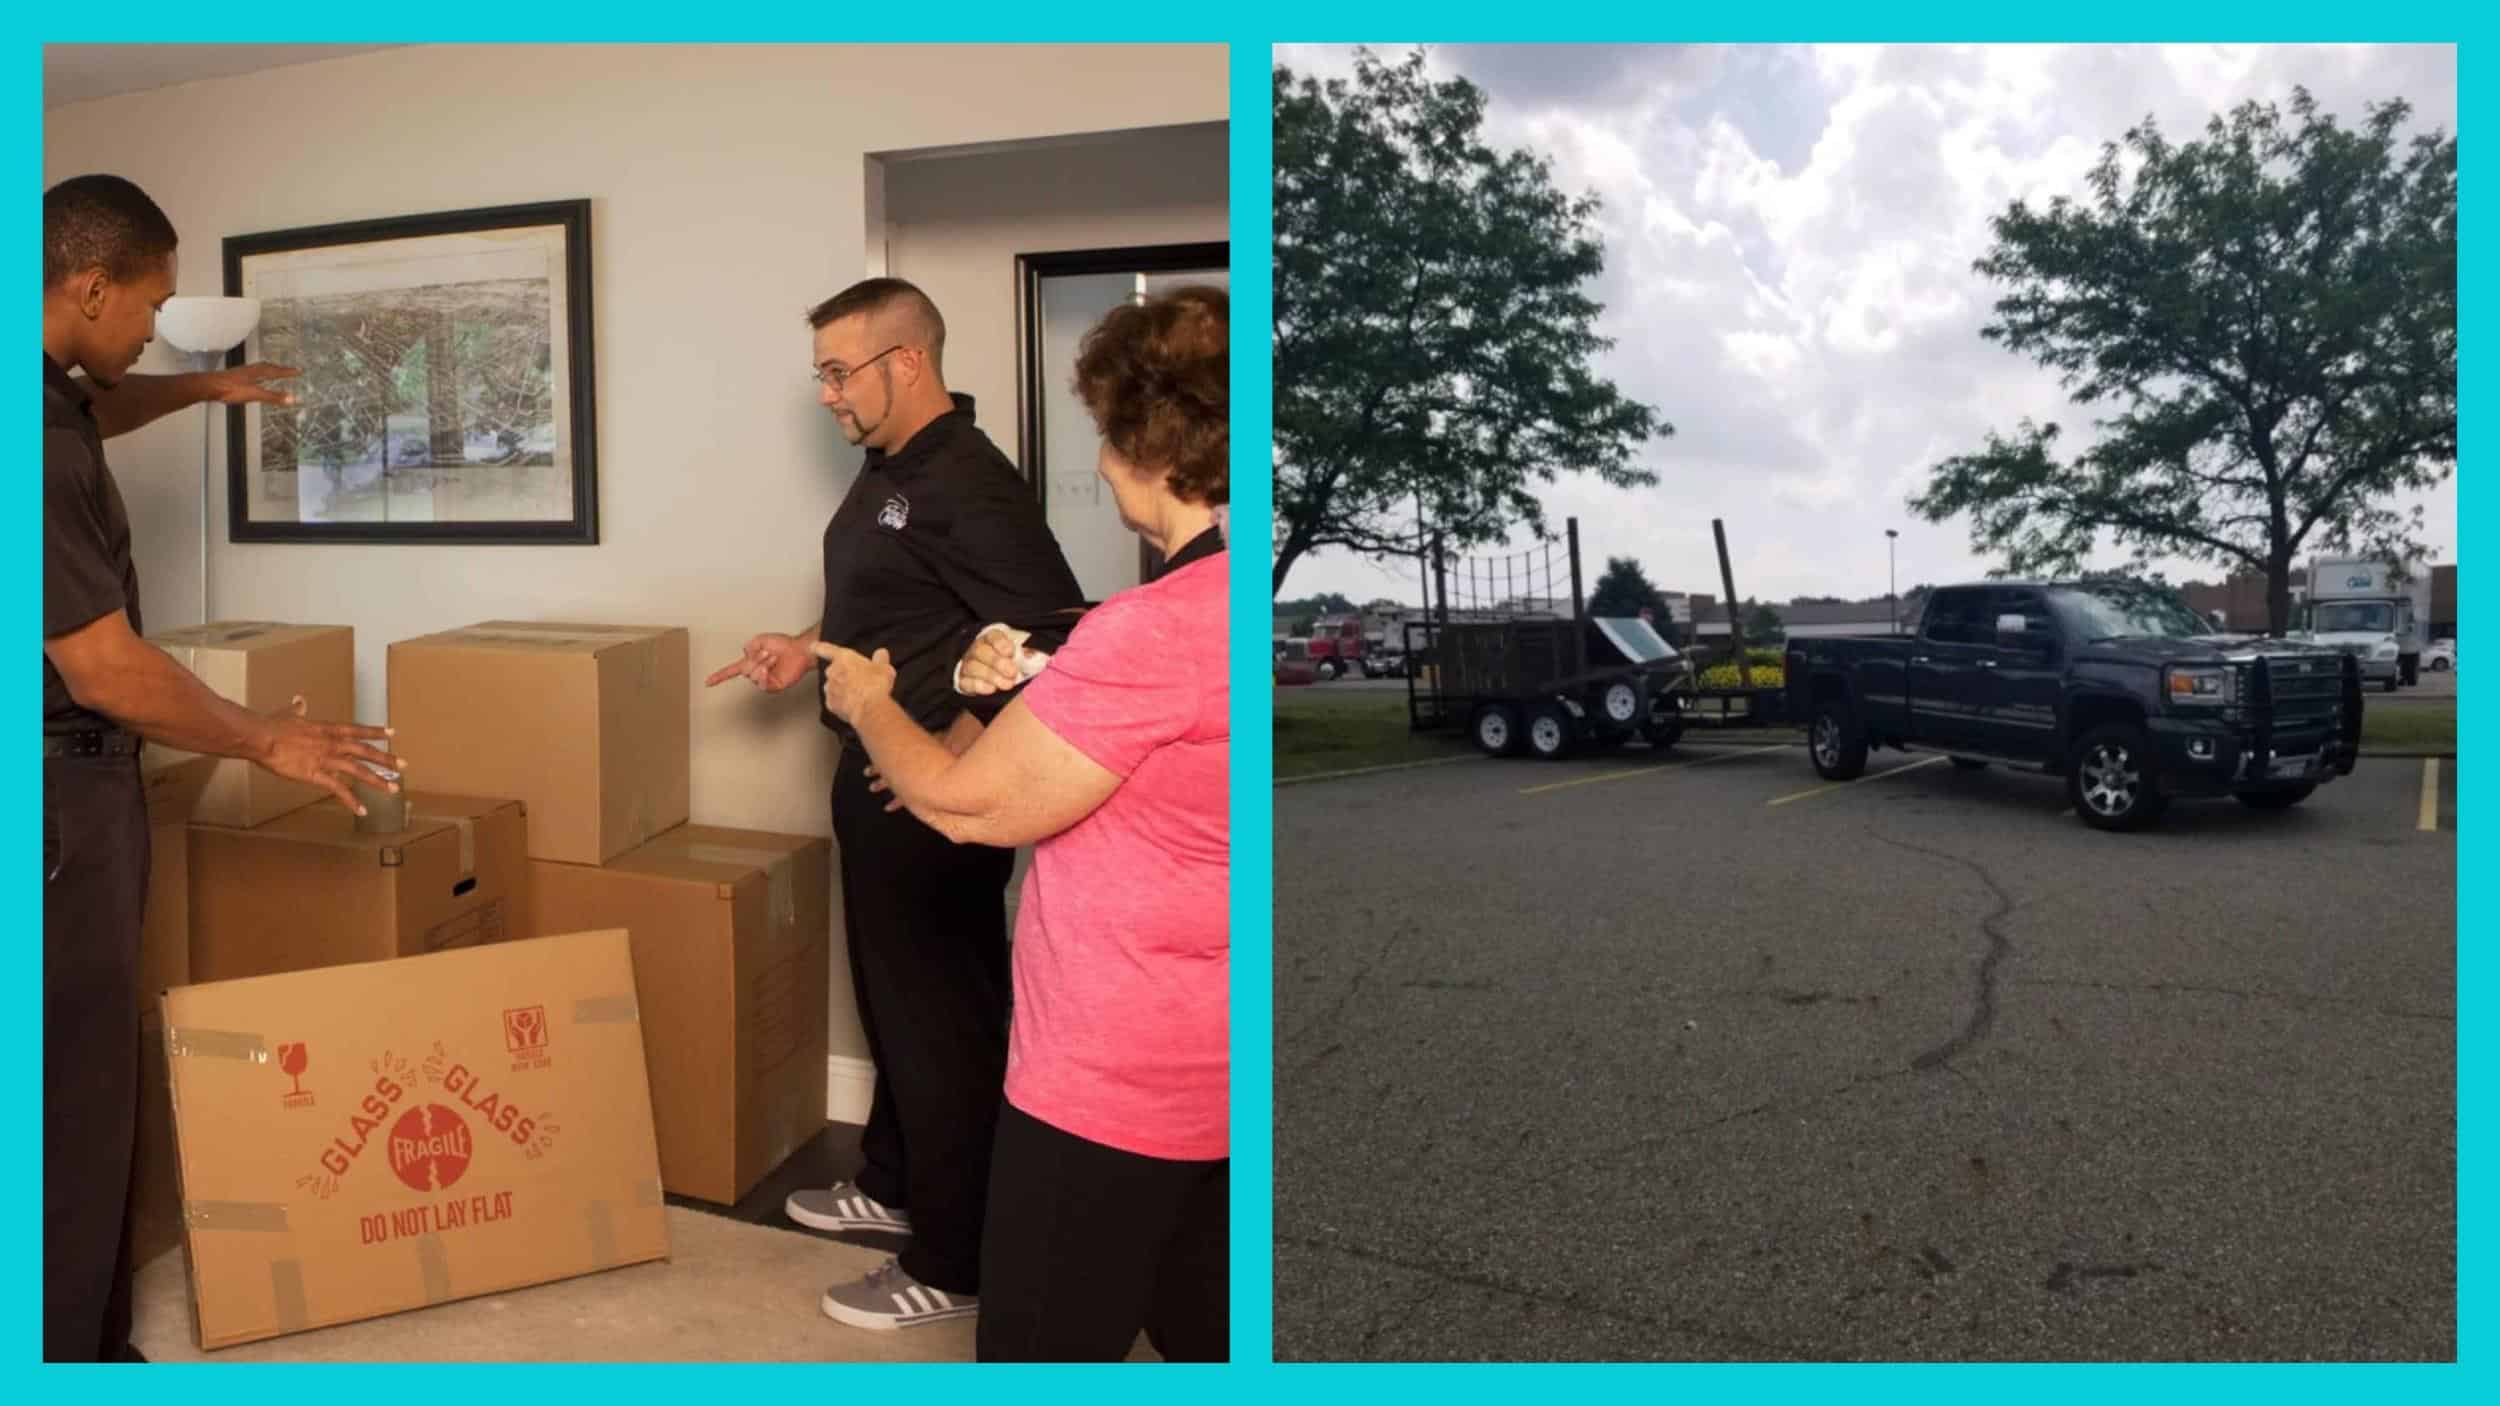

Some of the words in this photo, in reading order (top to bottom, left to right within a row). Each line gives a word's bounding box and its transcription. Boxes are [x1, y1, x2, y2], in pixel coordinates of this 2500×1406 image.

[320, 1076, 403, 1176] GLASS
[443, 1064, 535, 1145] GLASS
[393, 1124, 469, 1172] FRAGILE
[359, 1213, 388, 1245] DO
[392, 1205, 430, 1240] NOT
[433, 1199, 466, 1231] LAY
[472, 1191, 513, 1225] FLAT
